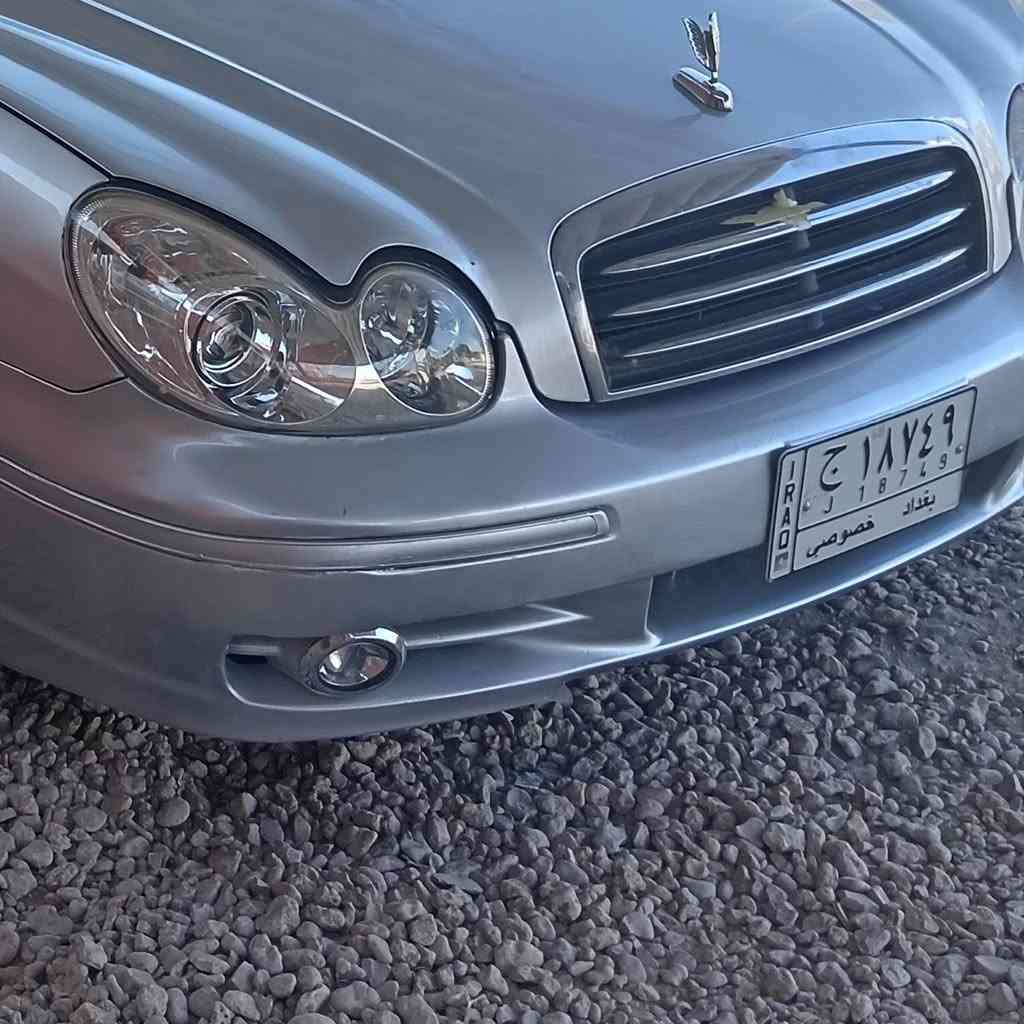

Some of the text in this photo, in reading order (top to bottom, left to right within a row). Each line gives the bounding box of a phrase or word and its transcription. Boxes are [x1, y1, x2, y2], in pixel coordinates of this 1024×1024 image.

[862, 403, 955, 480] ١٨٧٤٩
[805, 488, 936, 558] خصوصي بغداد
